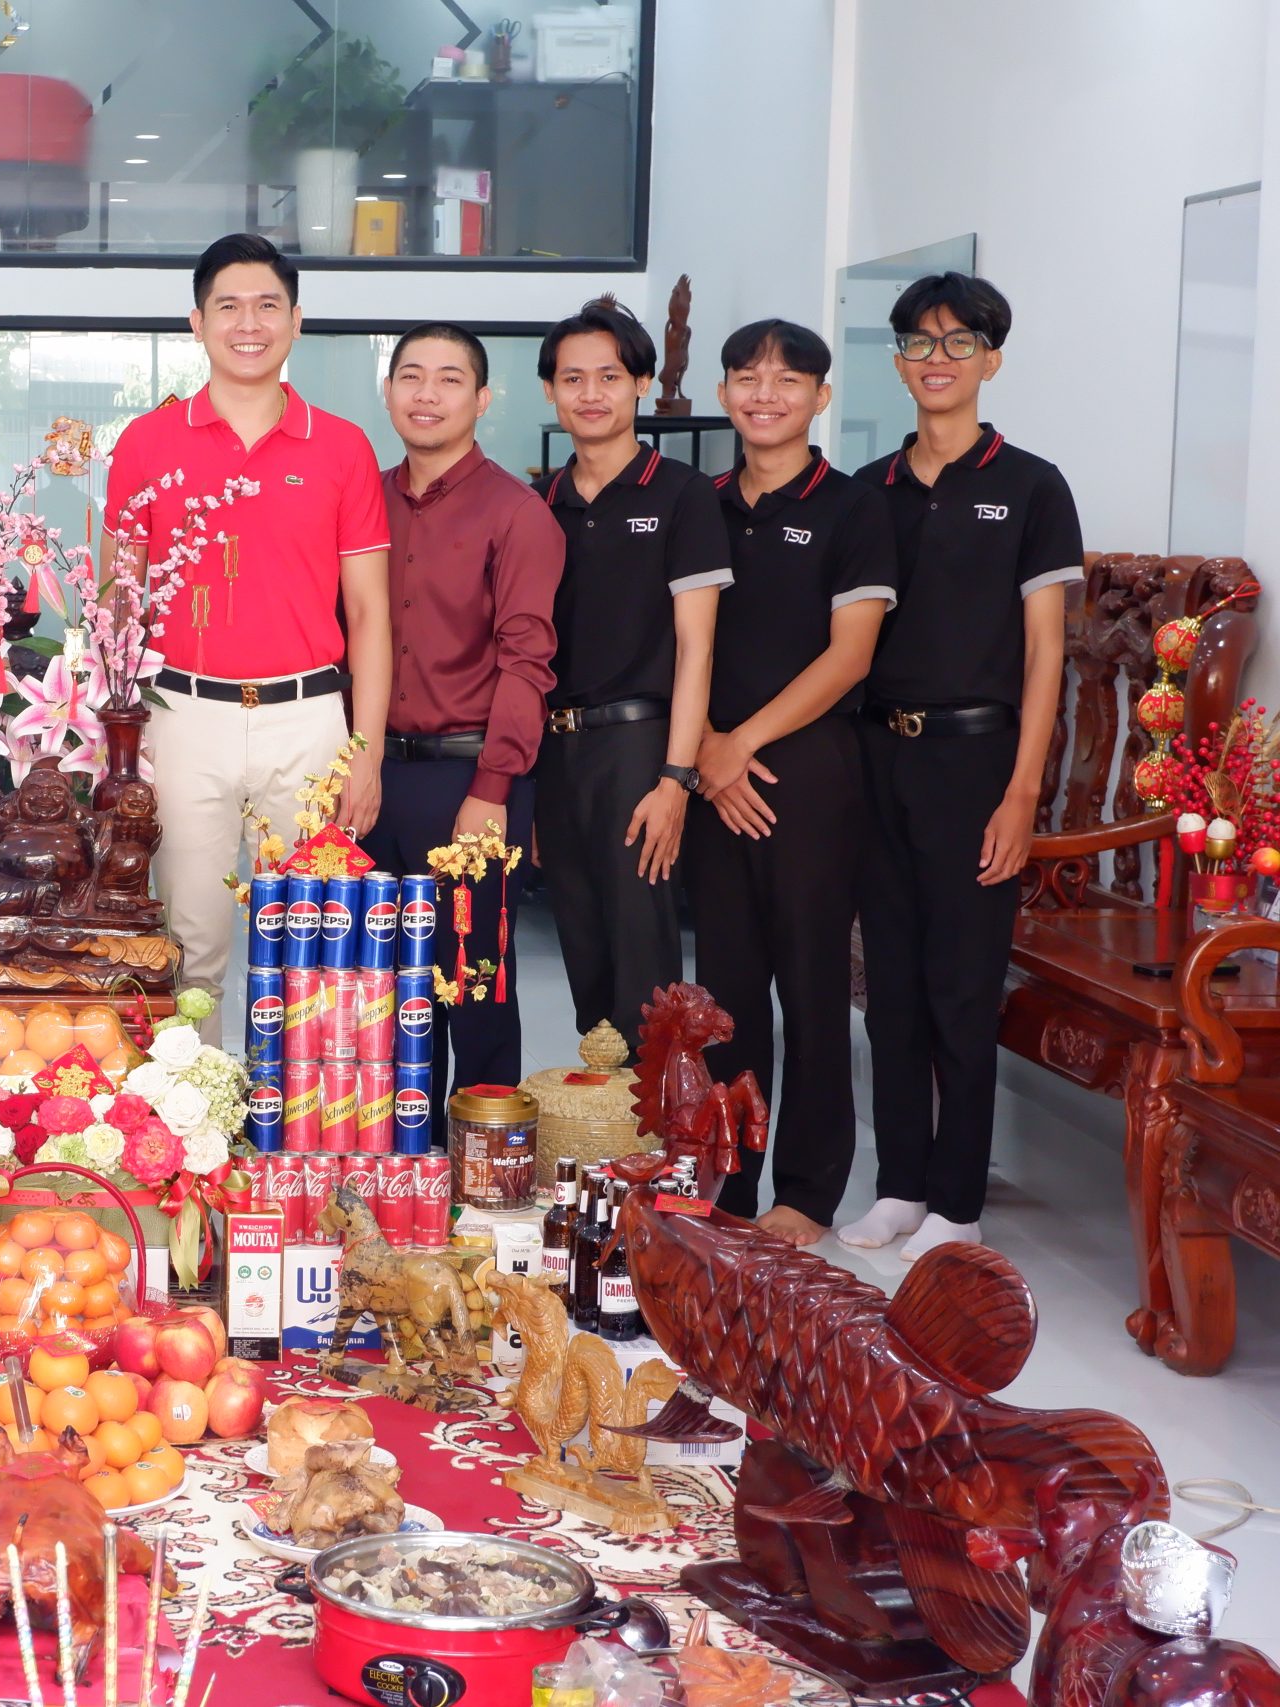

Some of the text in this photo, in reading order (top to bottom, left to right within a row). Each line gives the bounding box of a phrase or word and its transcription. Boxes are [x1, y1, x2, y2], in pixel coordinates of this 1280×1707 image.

[258, 916, 286, 926] PEPS
[287, 915, 320, 925] PEPSI
[367, 917, 395, 926] PEPS
[403, 915, 435, 924] PEPSI
[253, 1010, 283, 1020] PEPSI
[401, 1012, 432, 1021] PEPSI
[249, 1101, 282, 1110] PEPSI
[396, 1103, 428, 1112] PEPSI
[493, 1154, 534, 1166] Wafer Rolls
[233, 1232, 279, 1247] MOUTAI
[605, 1282, 635, 1298] CAMB
[369, 1669, 404, 1685] ELECTRIC
[376, 1681, 404, 1692] COOKER
